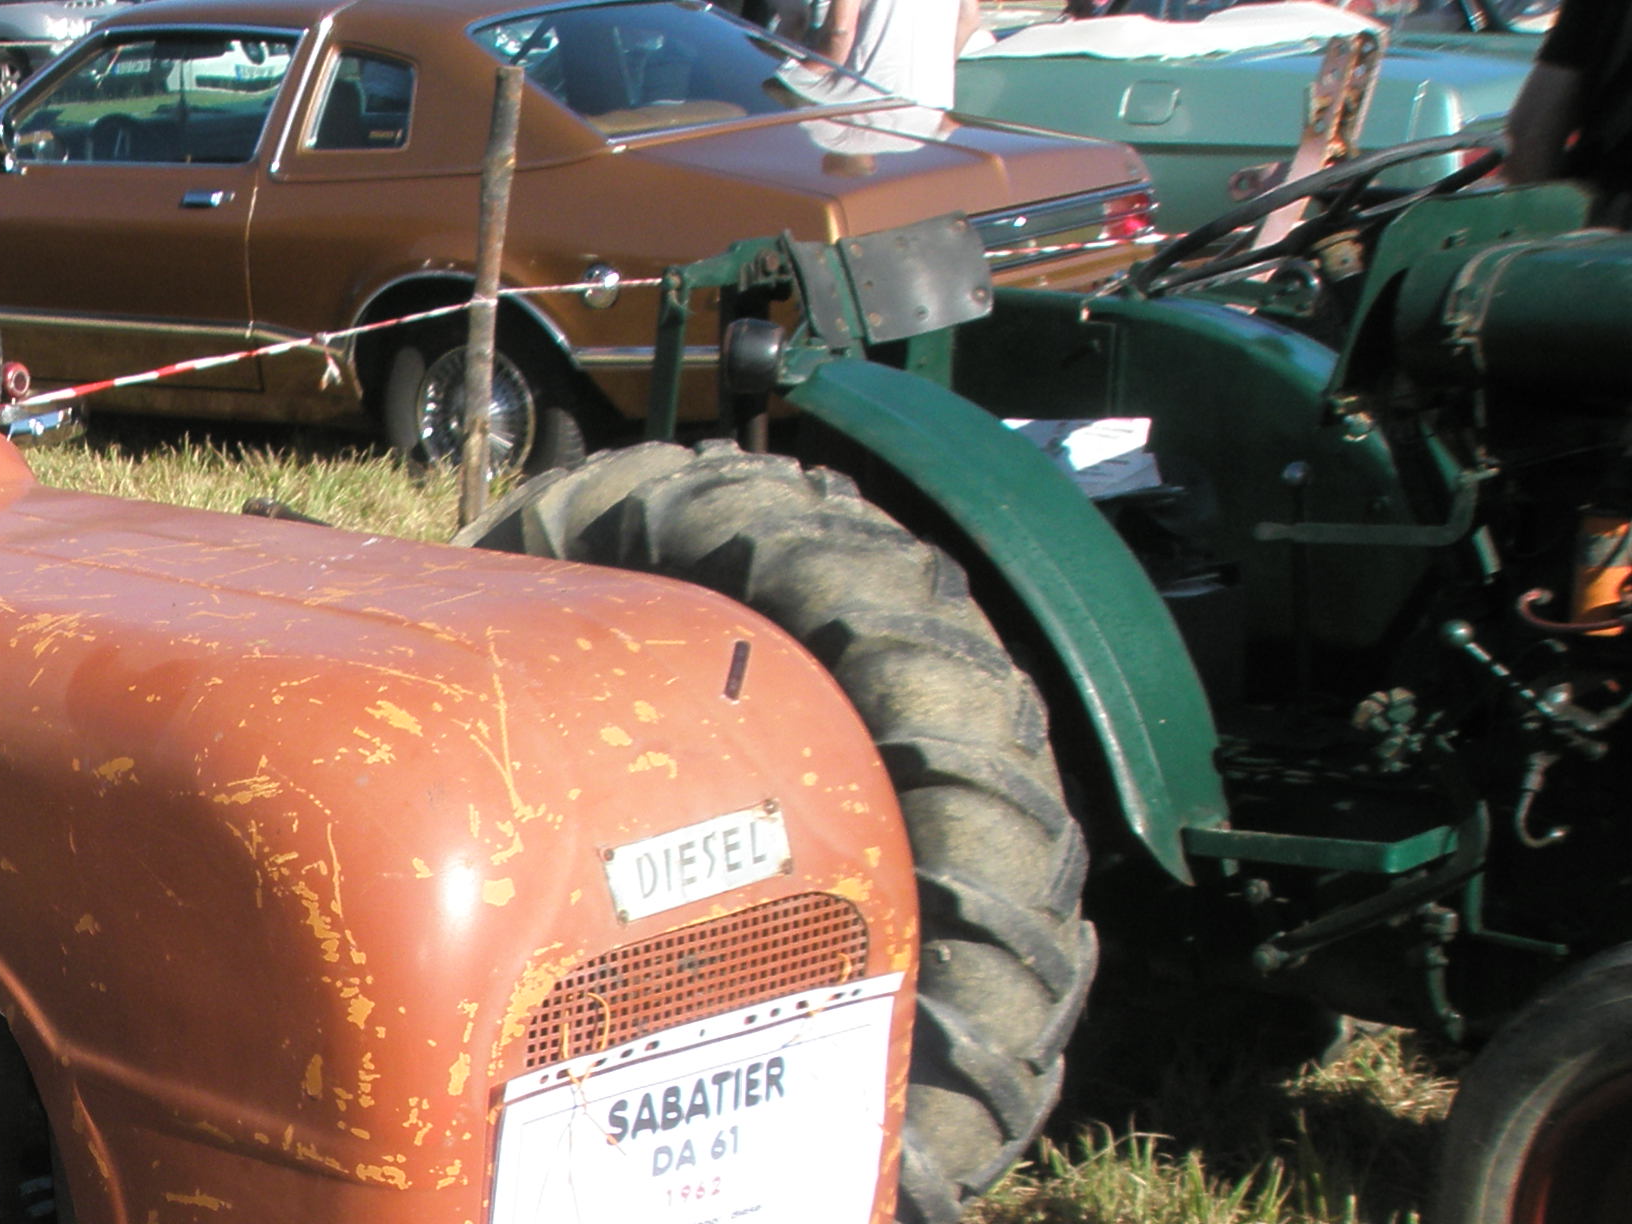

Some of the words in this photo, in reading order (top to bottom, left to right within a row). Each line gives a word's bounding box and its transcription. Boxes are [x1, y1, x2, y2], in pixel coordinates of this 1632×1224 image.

[635, 821, 767, 899] DIESEL
[606, 1056, 785, 1146] SABATIER
[652, 1138, 697, 1178] DA
[710, 1124, 740, 1161] 61
